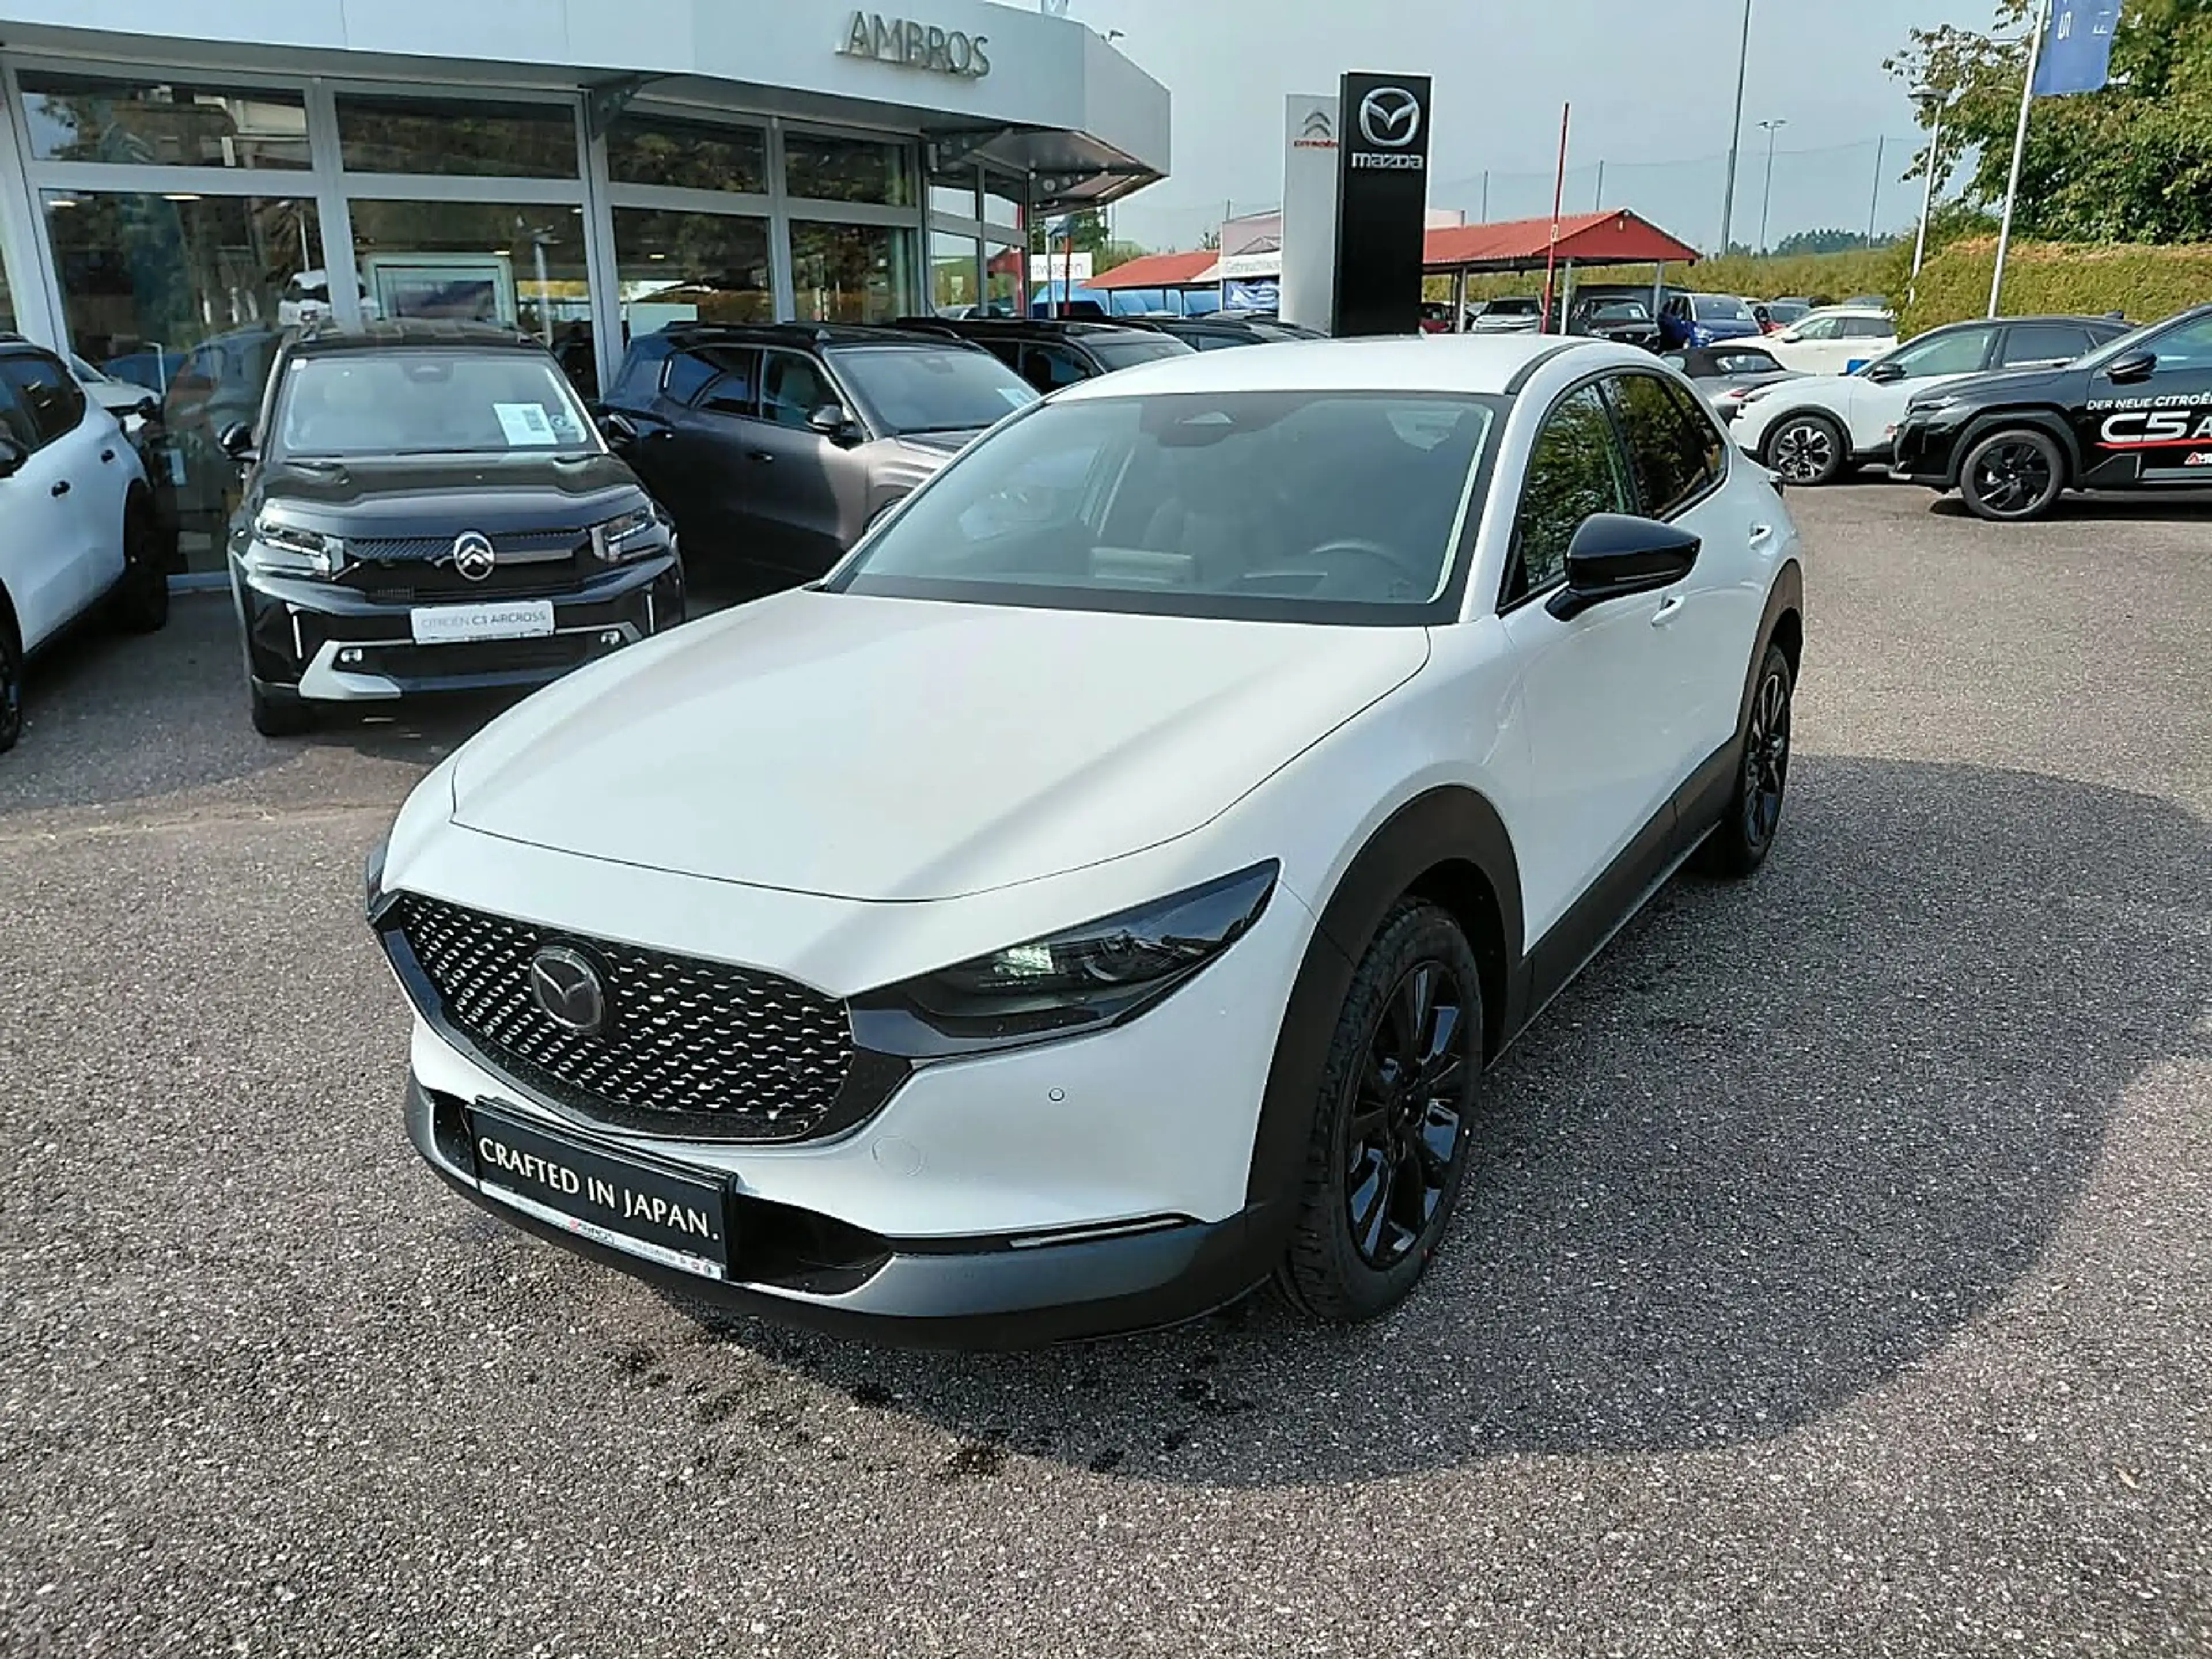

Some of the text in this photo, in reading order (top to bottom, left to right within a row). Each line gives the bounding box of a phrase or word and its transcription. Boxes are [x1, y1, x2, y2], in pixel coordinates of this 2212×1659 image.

[2056, 0, 2072, 40] S
[847, 10, 991, 79] AMBROS
[2086, 391, 2212, 410] DER NEUE CITROË
[2101, 410, 2191, 442] C5
[490, 609, 547, 624] AIRCROSS
[479, 1137, 580, 1195] CRAFTED
[587, 1176, 616, 1209] IN
[623, 1188, 720, 1241] JAPAN.
